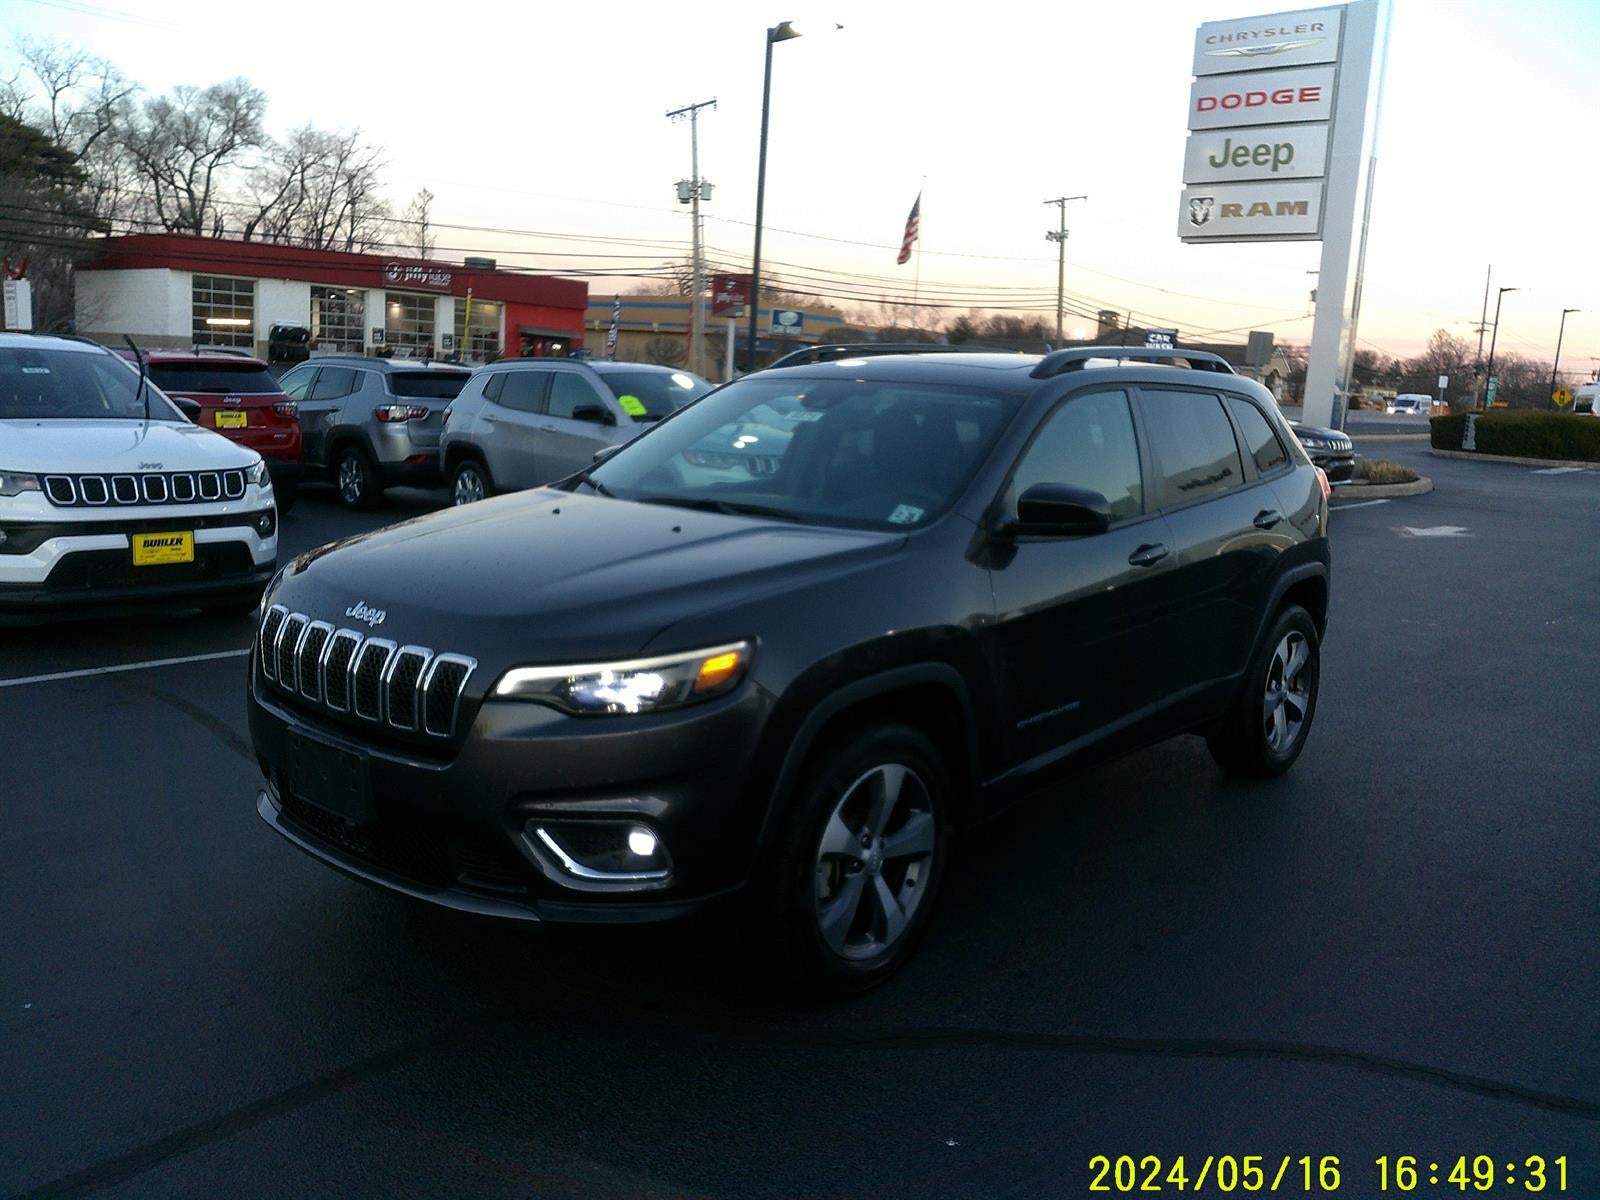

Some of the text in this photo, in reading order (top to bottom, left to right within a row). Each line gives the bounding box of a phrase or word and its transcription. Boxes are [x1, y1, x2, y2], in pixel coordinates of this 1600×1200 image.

[1205, 22, 1325, 45] CHRYSLER
[1196, 86, 1322, 112] DODGE
[1209, 138, 1295, 172] Jeep
[1220, 201, 1309, 218] RAM
[1148, 333, 1171, 343] CAR
[143, 537, 183, 548] BUHLER
[345, 600, 387, 628] Jeep
